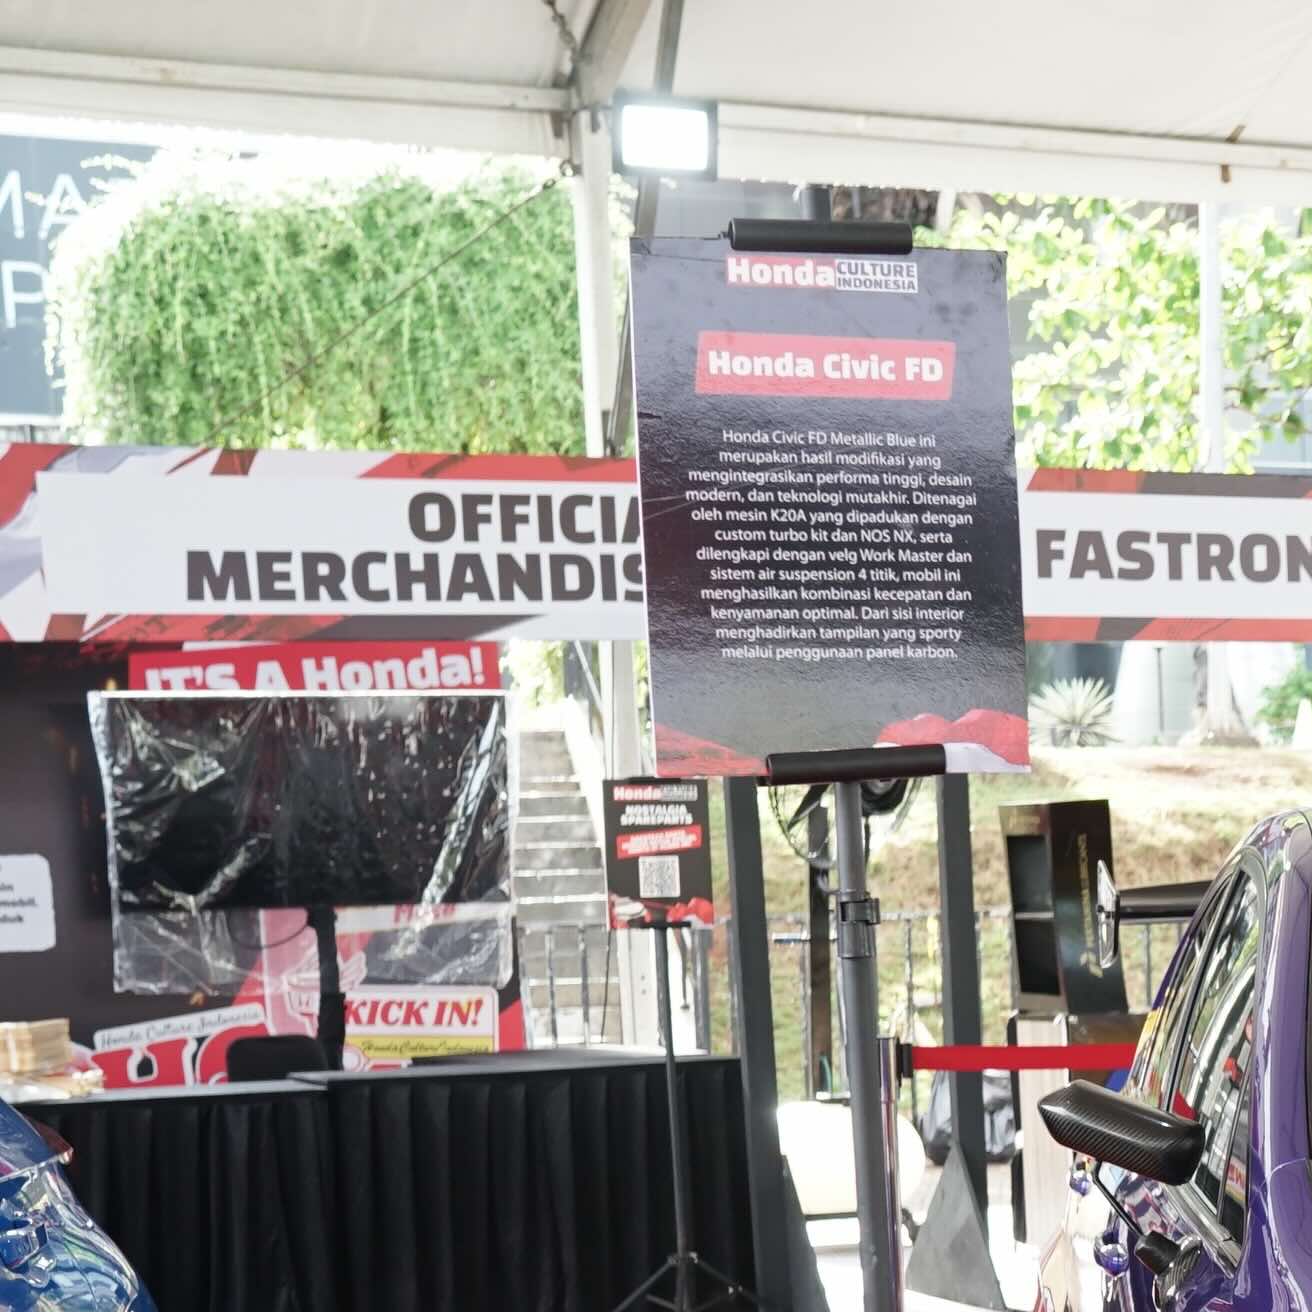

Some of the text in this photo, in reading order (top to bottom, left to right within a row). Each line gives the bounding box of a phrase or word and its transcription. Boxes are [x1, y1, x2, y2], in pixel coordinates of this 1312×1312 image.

[728, 257, 916, 285] Honda CULTURE
[838, 277, 917, 292] INDONESIA
[708, 351, 944, 382] Honda Civic FD
[722, 430, 936, 448] Honda Civic FD Metallic Blue ini
[719, 450, 941, 470] merupakan hasil modifikasi yang
[689, 470, 972, 489] mengintegrasikan performa tinggi, desain
[686, 489, 977, 507] modern, dan teknologi mutakhir. Ditenagai
[407, 492, 640, 544] OFFICI
[691, 508, 972, 526] oleh mesin K20A yang dipadukan dengan
[715, 528, 952, 545] custom turbo kit dan NOS NX, serta
[697, 547, 972, 564] dilengkapi dengan velg Work Master dan
[186, 551, 644, 603] MERCHANDIS
[710, 567, 960, 583] sistem air suspension 4 titik, mobil ini
[701, 586, 972, 602] menghasilkan kombinasi kecepatan dan
[711, 606, 964, 622] kenyamanan optimal. Dari sisi interior
[716, 625, 961, 642] menghadirkan tampilan yang sporty
[722, 645, 958, 661] melalui penggunaan panel karbon.
[255, 661, 290, 690] A
[301, 647, 485, 690] Honda!
[344, 997, 483, 1026] KICK IN!
